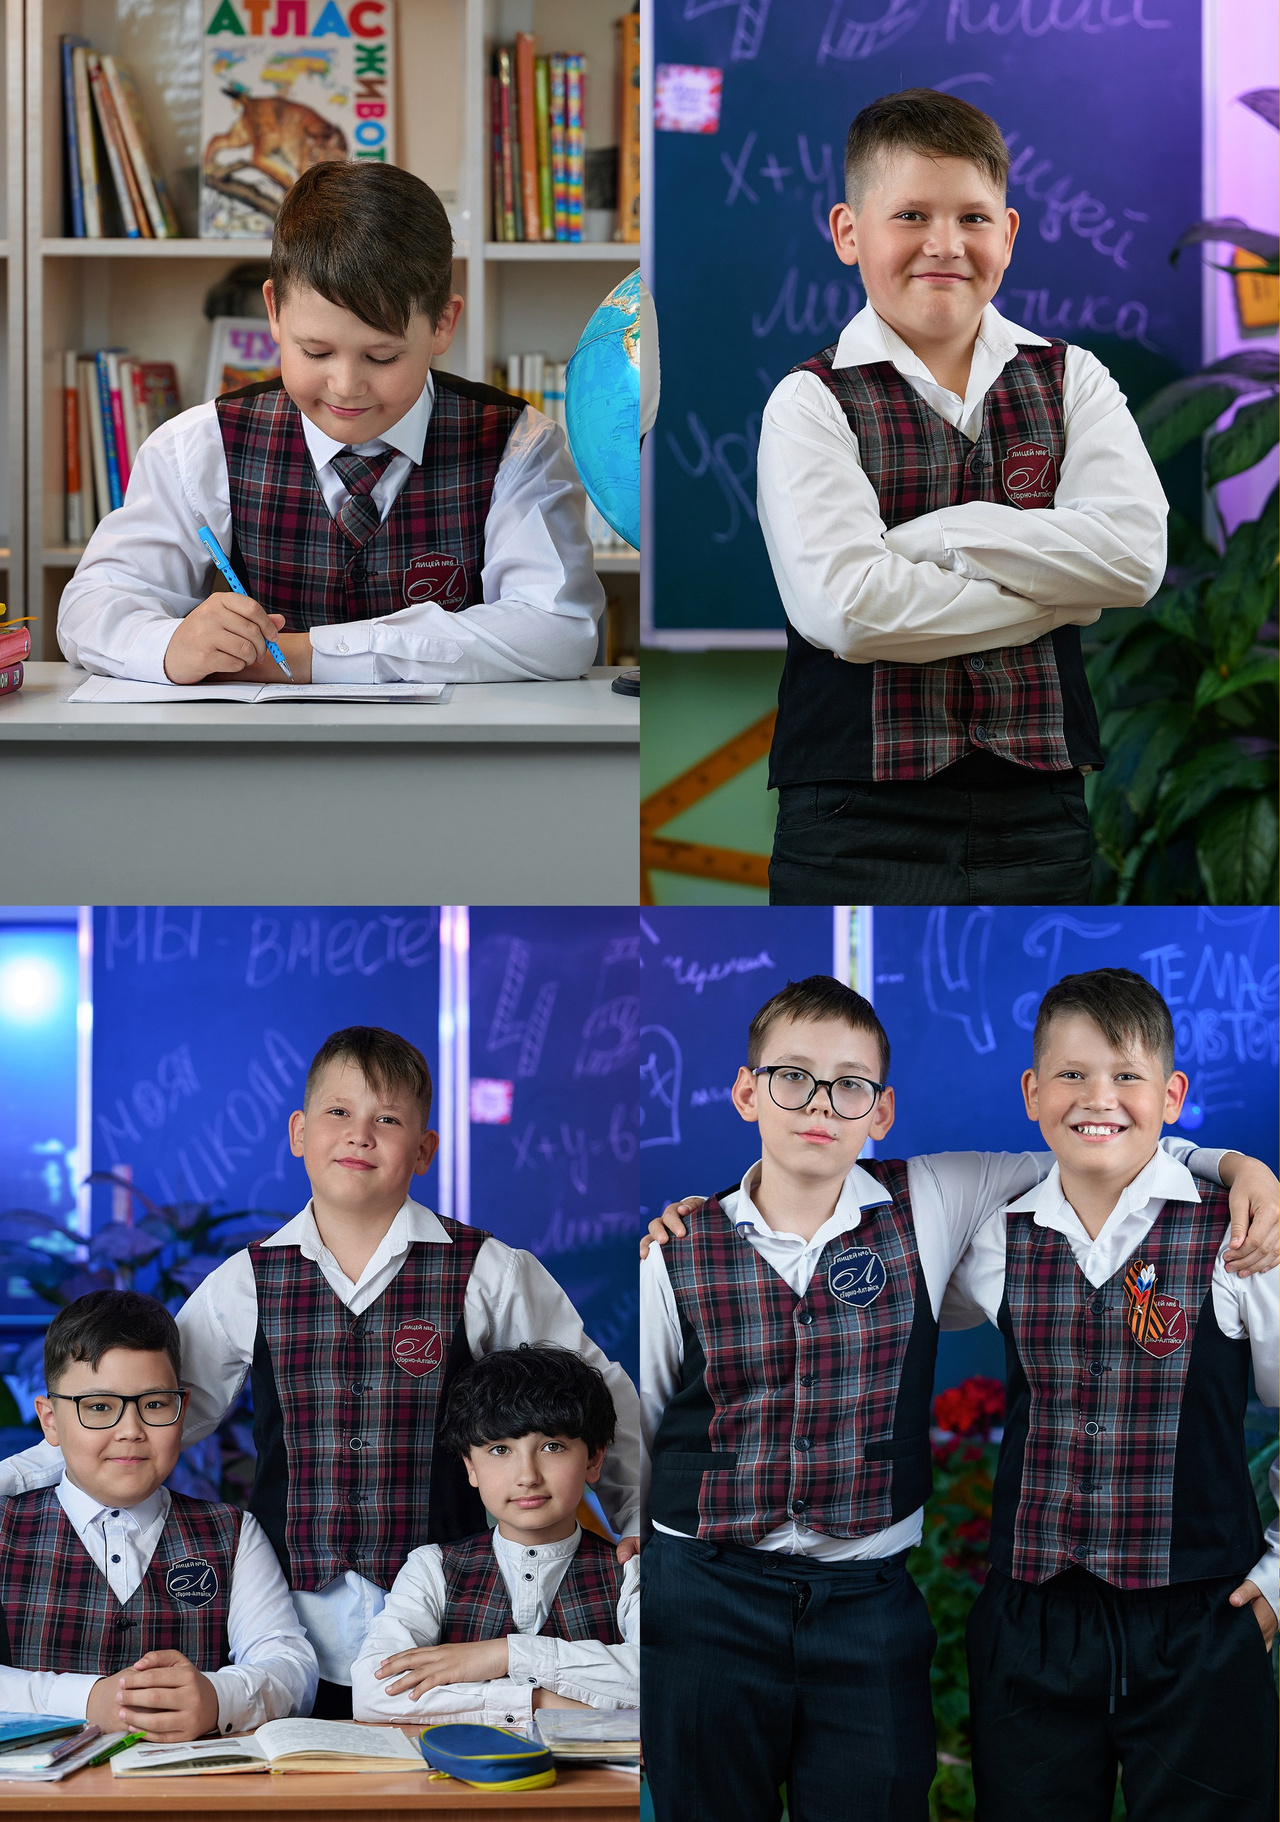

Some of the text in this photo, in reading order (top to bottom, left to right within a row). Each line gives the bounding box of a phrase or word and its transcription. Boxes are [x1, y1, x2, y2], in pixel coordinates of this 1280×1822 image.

[206, 0, 386, 38] АТЛАС
[1003, 131, 1149, 270] ицей
[1012, 449, 1035, 457] ЛИЦЕЙ
[415, 559, 440, 568] ЛИЦЕЙ
[97, 1042, 200, 1163] МОЯ
[836, 1252, 858, 1262] ЛИЦЕЙ
